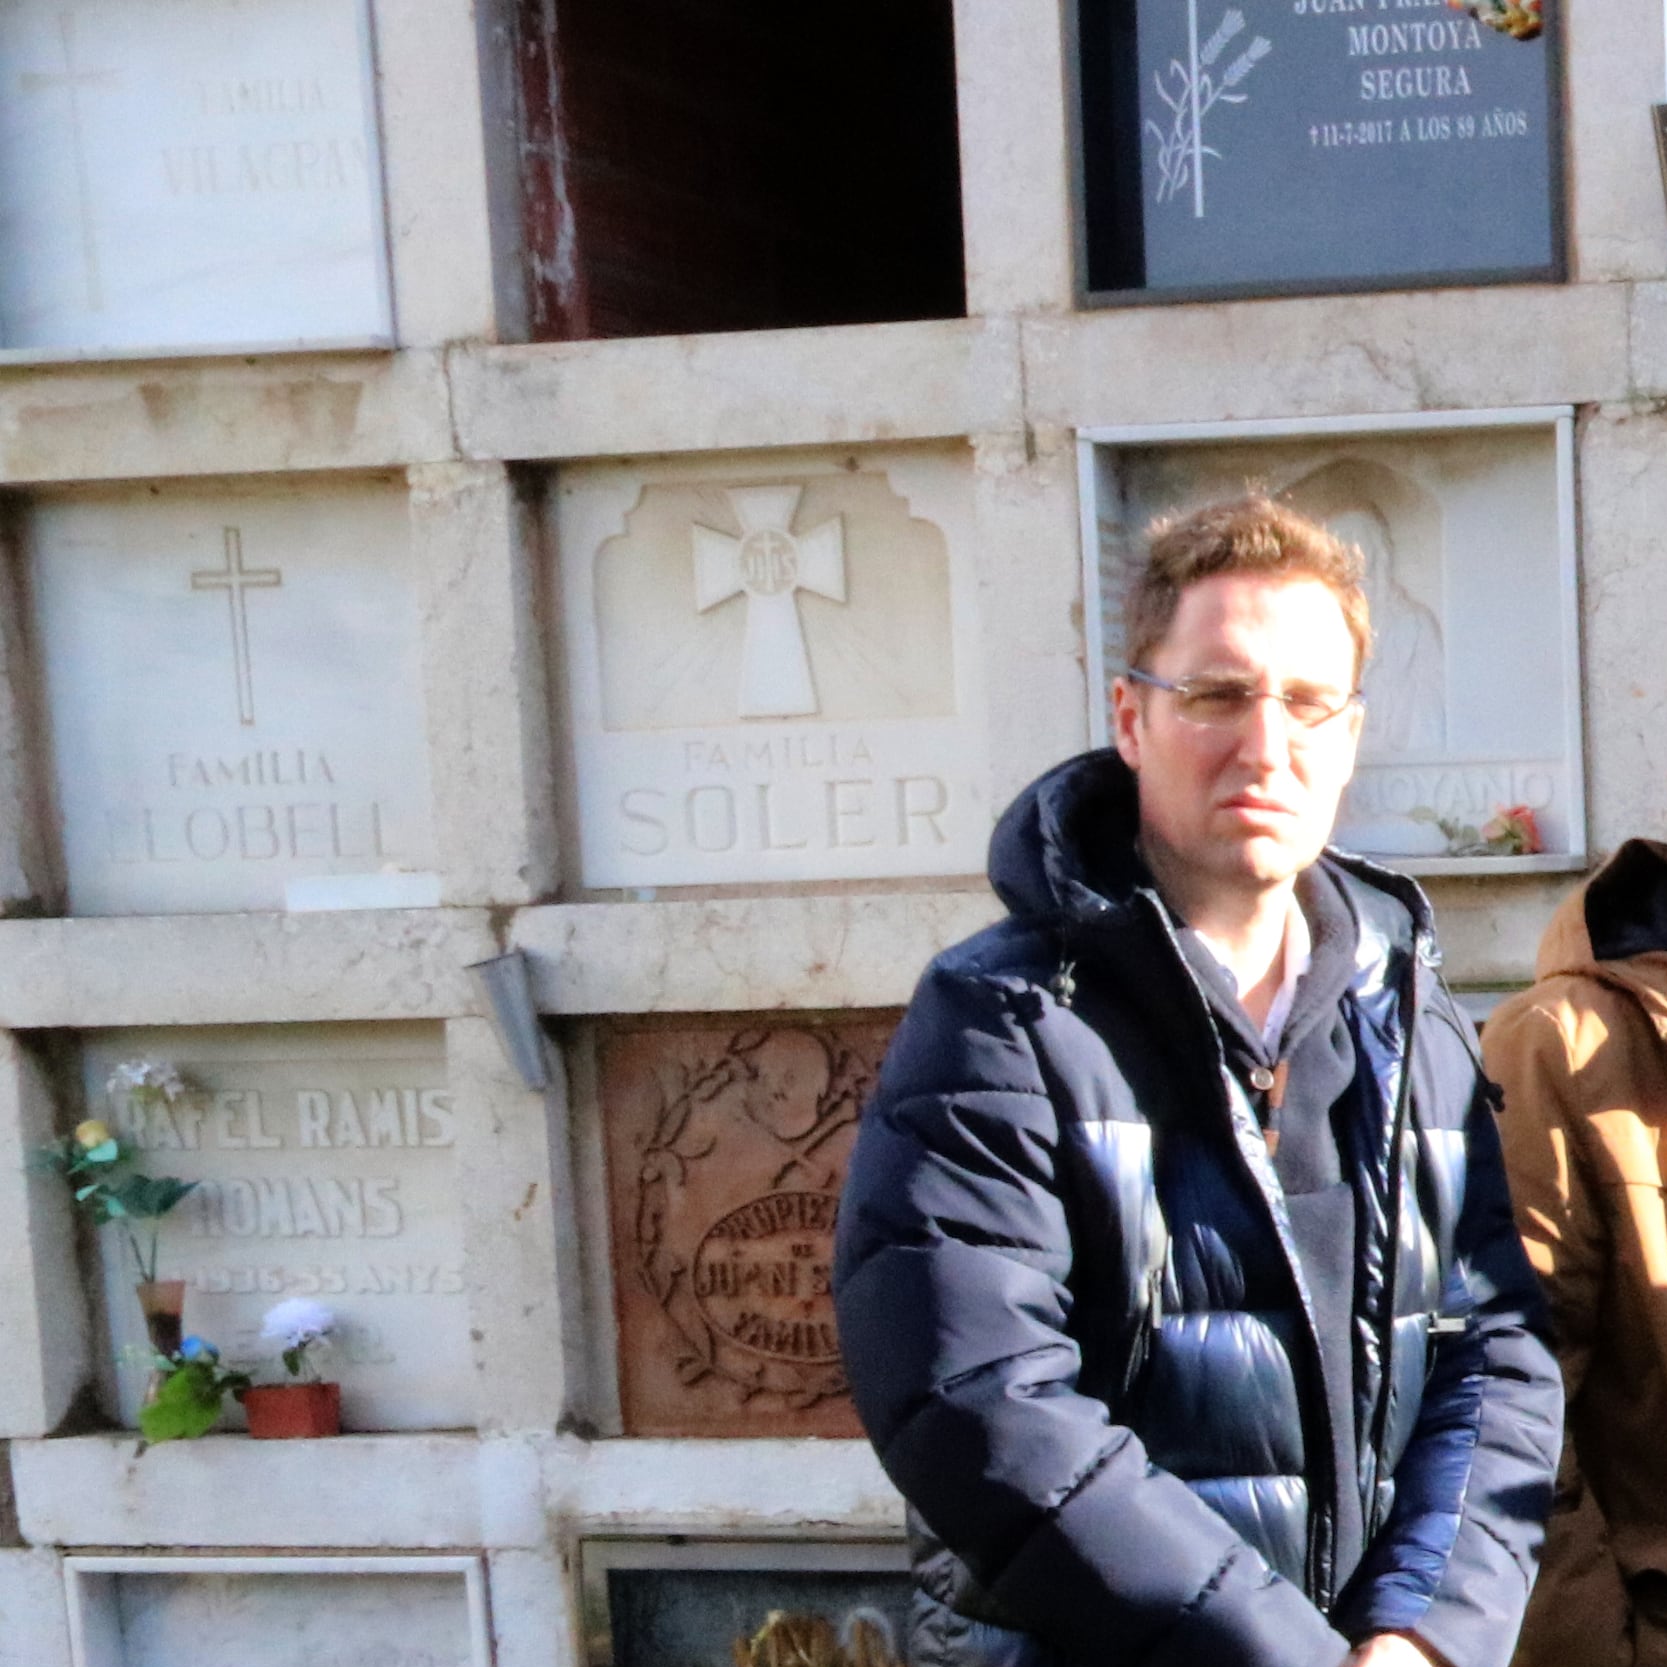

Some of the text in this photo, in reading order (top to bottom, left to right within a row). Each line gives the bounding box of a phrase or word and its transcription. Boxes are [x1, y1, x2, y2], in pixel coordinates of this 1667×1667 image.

[1347, 20, 1482, 57] MONTOYA
[1360, 65, 1473, 101] SEGURA
[1399, 119, 1412, 142] A
[1418, 115, 1452, 142] LOS
[1482, 107, 1529, 138] AÑOS
[166, 747, 337, 790] FAMILIA
[683, 732, 875, 773] FAMILIA
[104, 800, 406, 866] LLOBELL
[618, 773, 950, 858] SOLER
[296, 1085, 457, 1149] RAMIS
[698, 1259, 798, 1298] JUAN
